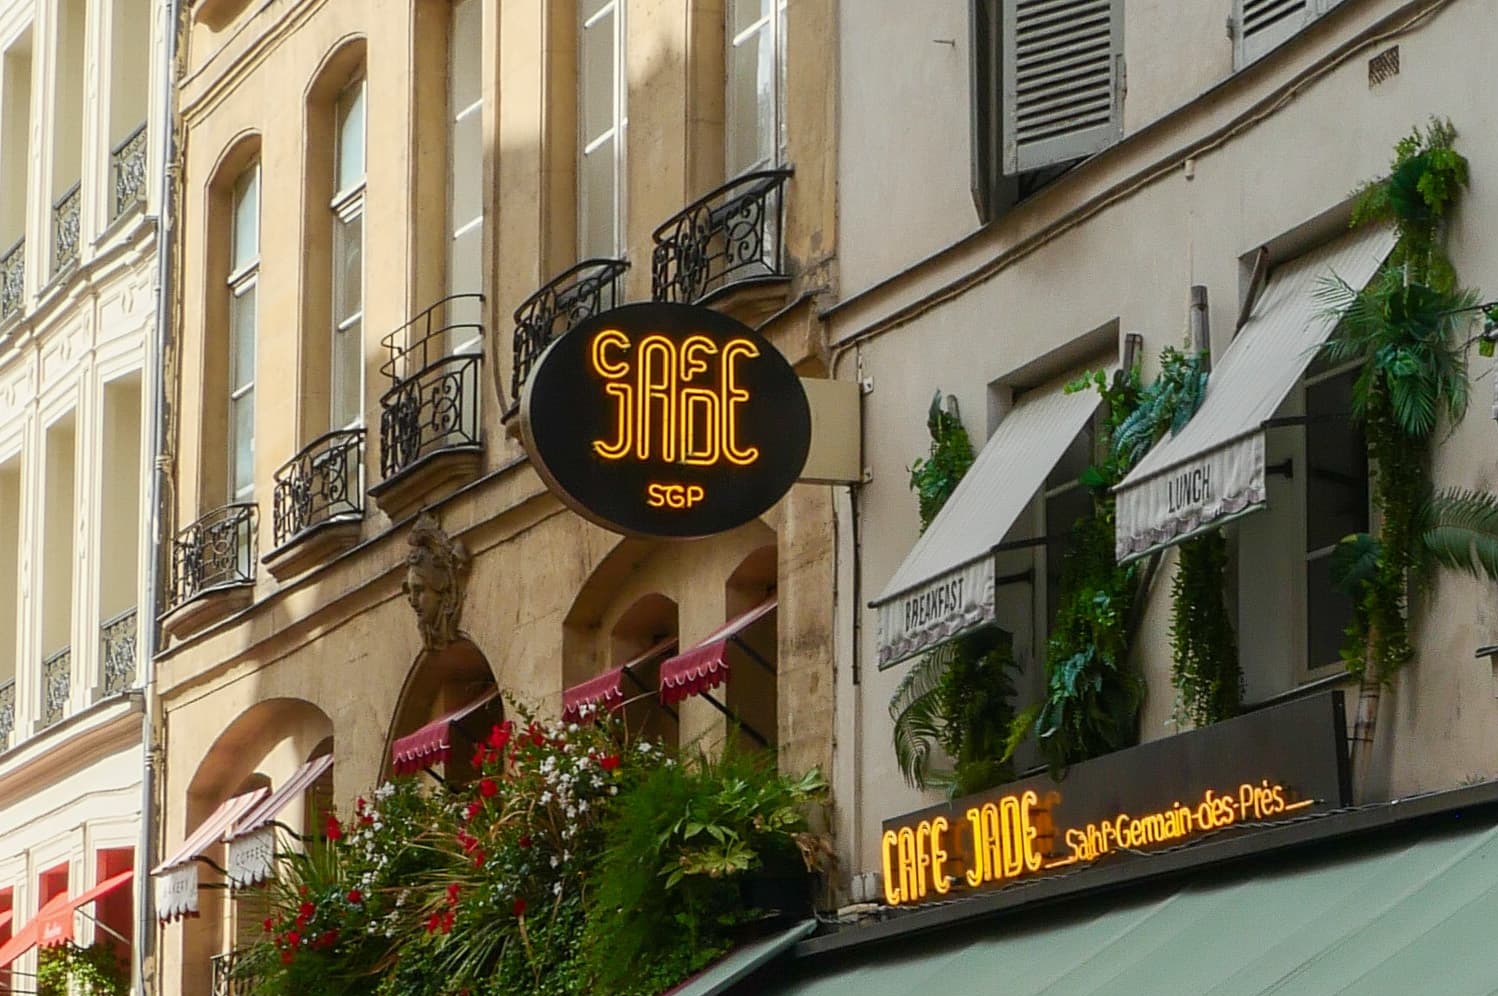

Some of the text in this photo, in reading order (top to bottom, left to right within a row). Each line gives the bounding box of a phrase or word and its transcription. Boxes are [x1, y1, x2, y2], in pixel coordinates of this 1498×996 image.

[647, 483, 705, 509] SGP
[1168, 463, 1211, 514] LUNCH
[905, 577, 964, 632] BREAKFAST
[881, 815, 951, 906] CAFE
[965, 788, 1043, 888] JADE
